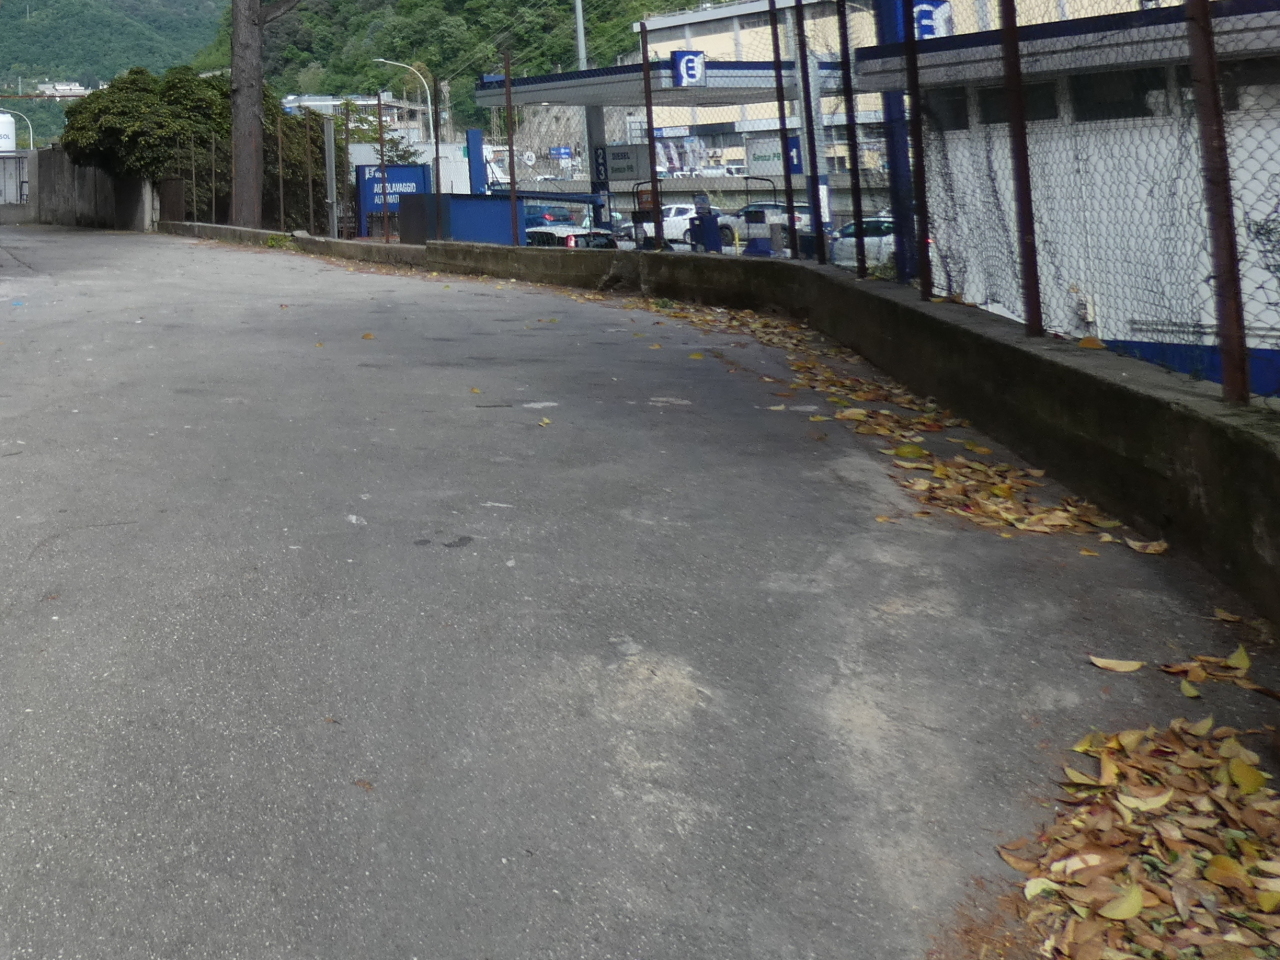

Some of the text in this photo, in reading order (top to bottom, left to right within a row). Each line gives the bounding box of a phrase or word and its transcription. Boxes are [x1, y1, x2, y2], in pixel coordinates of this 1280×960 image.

[597, 149, 604, 163] 2
[612, 152, 631, 160] DIESEL
[790, 148, 798, 165] 1
[599, 166, 605, 180] 3
